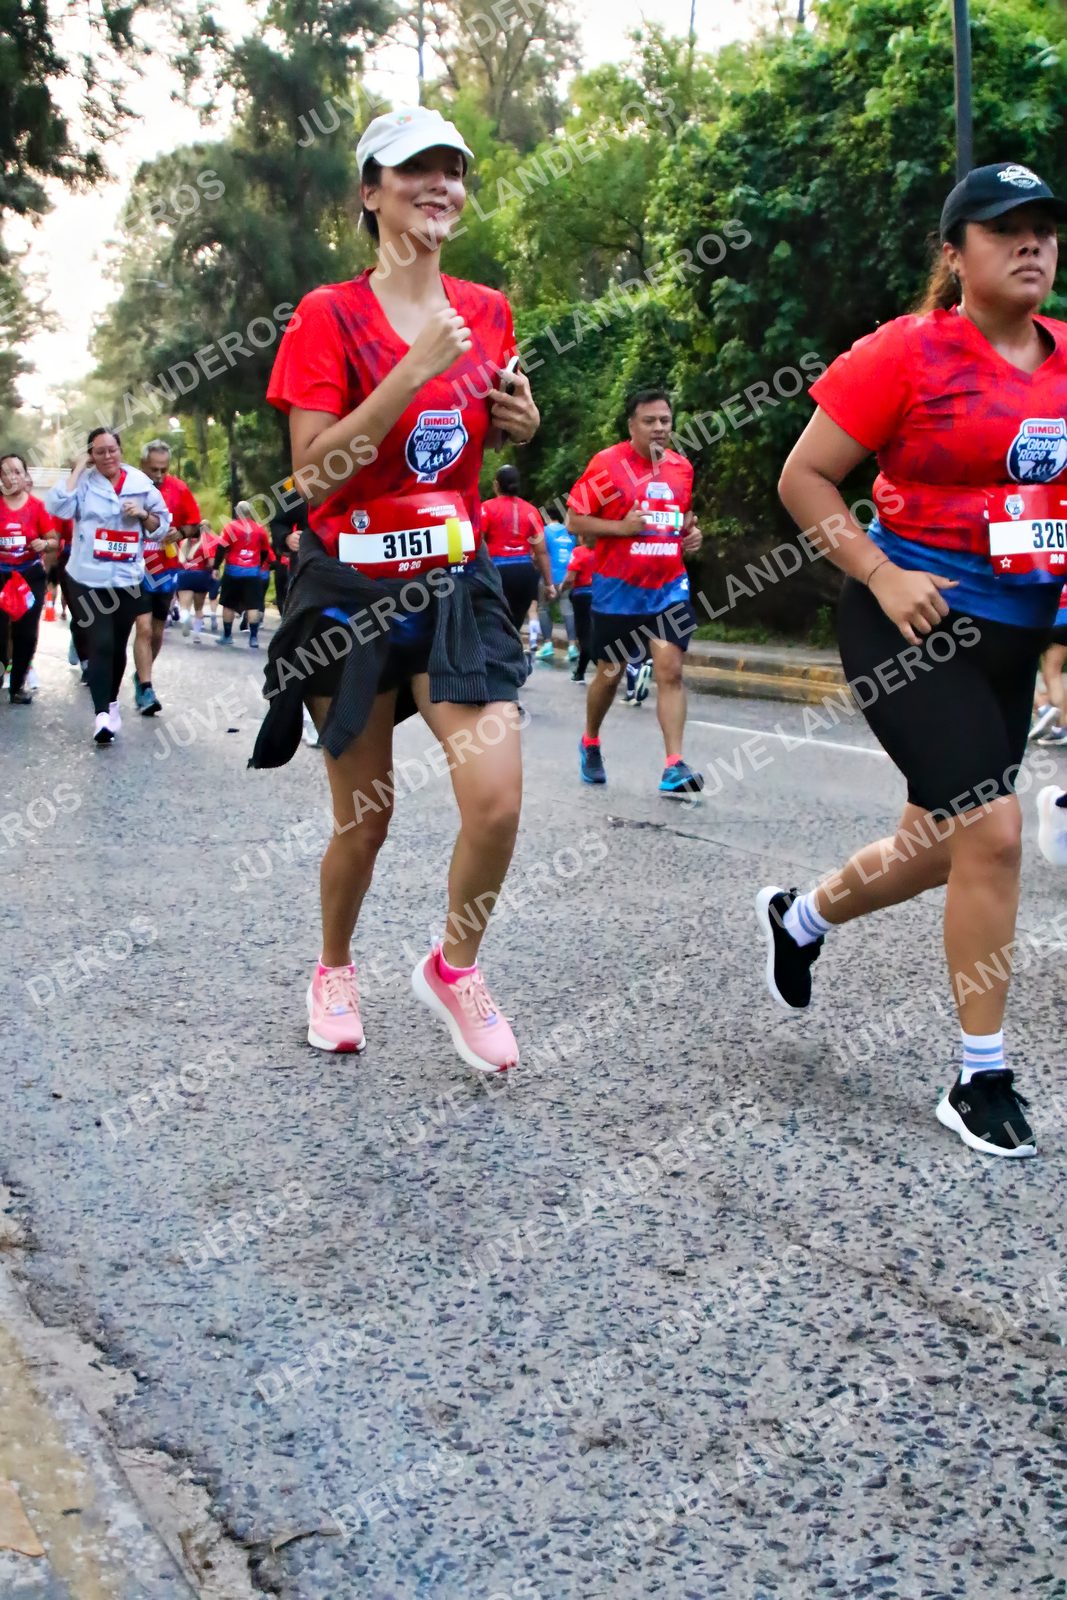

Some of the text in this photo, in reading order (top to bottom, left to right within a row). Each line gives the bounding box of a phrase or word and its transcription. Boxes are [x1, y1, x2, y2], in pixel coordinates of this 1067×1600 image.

[423, 428, 455, 442] Global
[414, 440, 440, 451] Race
[1027, 437, 1060, 452] Global
[1018, 449, 1047, 461] Race
[1031, 521, 1067, 549] 326
[382, 529, 432, 559] 3151
